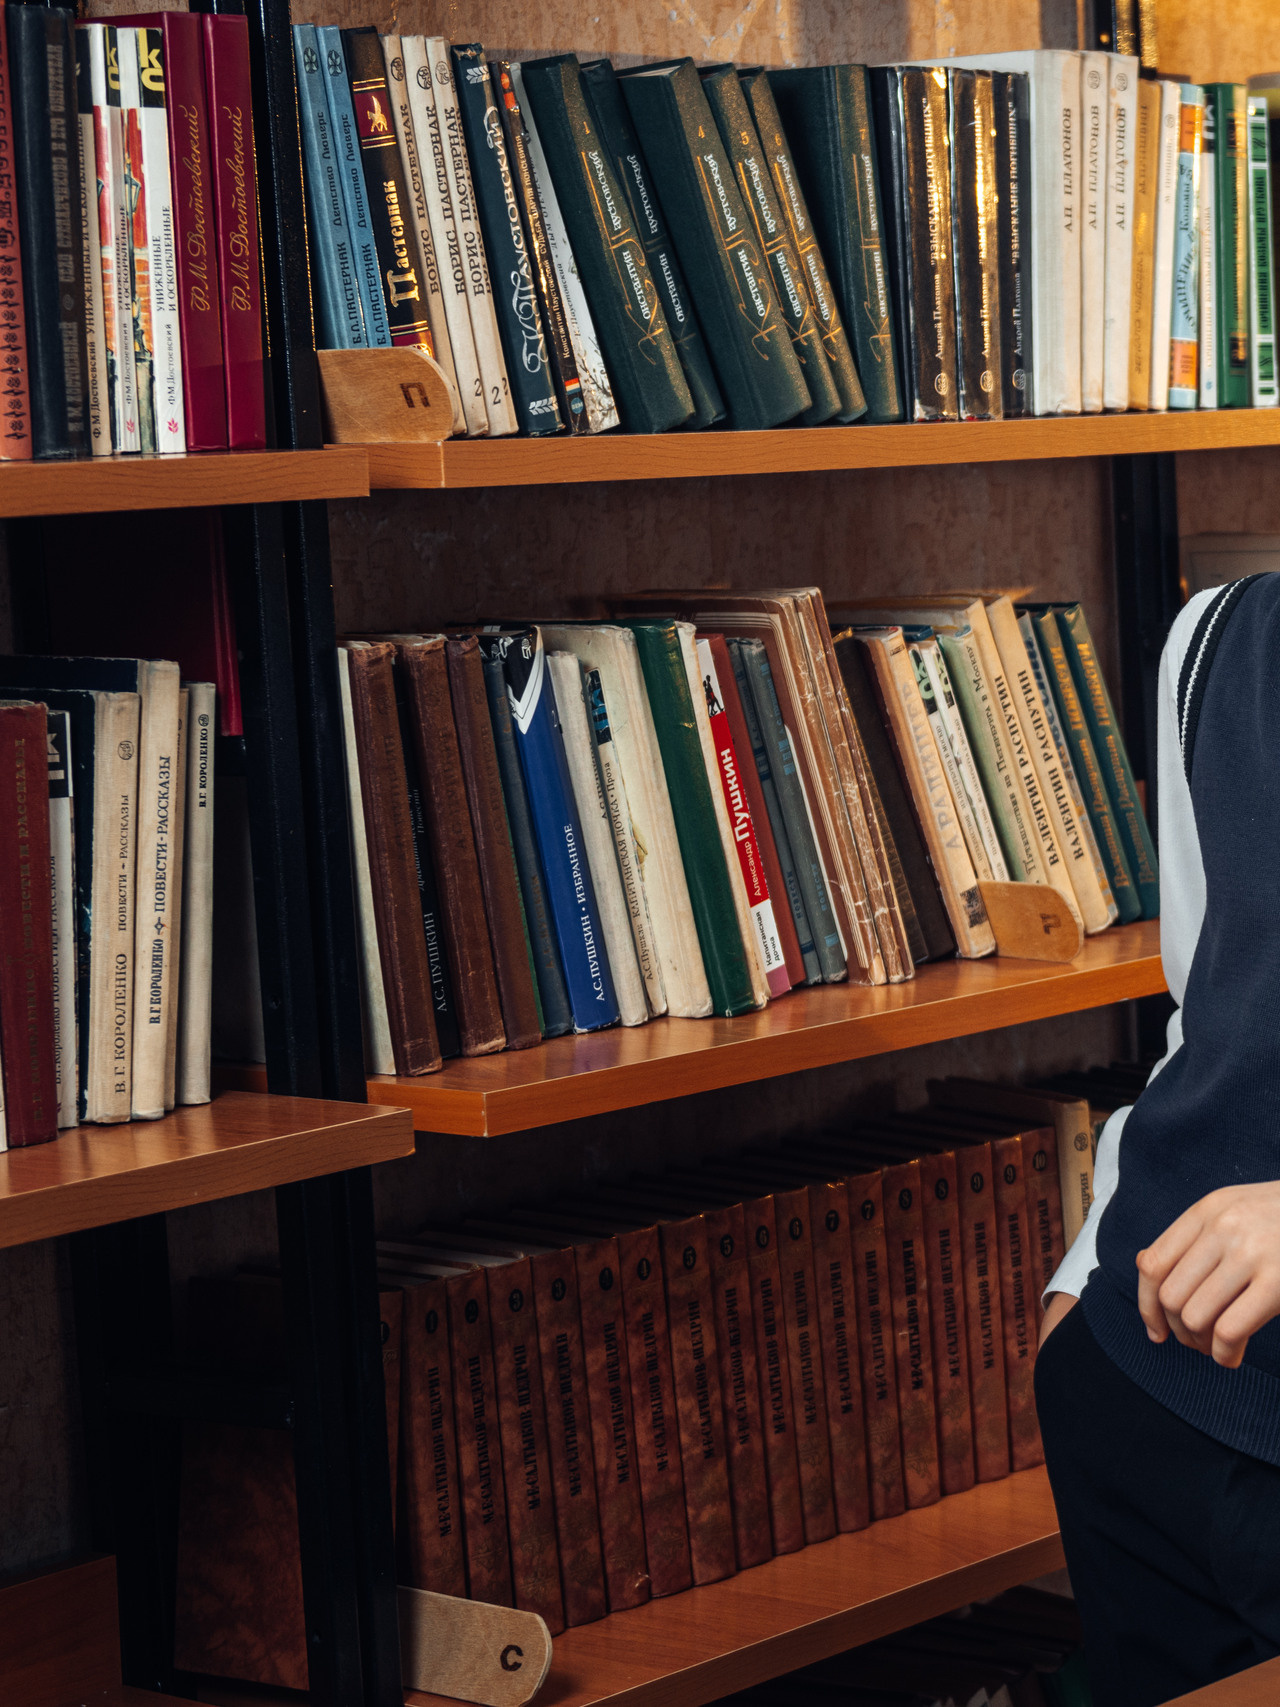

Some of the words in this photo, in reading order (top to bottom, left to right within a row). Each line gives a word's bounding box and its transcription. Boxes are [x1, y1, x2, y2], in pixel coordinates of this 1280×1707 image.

[316, 111, 331, 160] Люверс
[340, 113, 355, 162] Люверс
[399, 103, 426, 220] ПАСТЕРНАК
[425, 105, 451, 220] ПАСТЕРНАК
[443, 106, 471, 222] ПАСТЕРНАК
[514, 134, 533, 187] ЛОНСЕВИЛЯ
[1062, 107, 1073, 196] ПЛАТОНОВ
[1087, 105, 1099, 193] ПЛАТОНОВ
[1115, 107, 1126, 193] ПЛАТОНОВ
[325, 166, 342, 227] Детство
[350, 168, 367, 228] Детство
[526, 187, 540, 219] ШАРЛЯ
[162, 205, 175, 300] ОСКОРБЛЕННЫЕ
[382, 179, 420, 308] Пастернак
[420, 229, 440, 295] БОРИС
[444, 229, 466, 295] БОРИС
[464, 231, 486, 297] БОРИС
[532, 221, 547, 255] СУДЬБА
[82, 246, 95, 334] УНИЖЕННЫЕ
[151, 235, 164, 311] УНИЖЕННЫЕ
[542, 259, 561, 311] Паустовский
[932, 273, 943, 321] Платонов
[1011, 272, 1022, 318] Платонов
[554, 311, 571, 359] Константин
[934, 321, 944, 361] Андрей
[1013, 319, 1022, 356] Андрей
[400, 381, 430, 408] П
[492, 386, 501, 405] 2
[1017, 669, 1054, 763] РАСПУТИН
[1051, 646, 1083, 730] ПОВЕСТИ
[1077, 643, 1111, 726] ПОВЕСТИ
[993, 675, 1029, 768] РАСПУТИН
[199, 728, 208, 788] КОРОЛЕНКО
[603, 761, 615, 792] Проза
[118, 794, 130, 859] РАССКАЗЫ
[610, 799, 626, 836] ДОЧКА
[721, 748, 751, 842] Пушкин
[1023, 773, 1060, 866] ВАЛЕНТИН
[1048, 766, 1085, 861] ВАЛЕНТИН
[564, 823, 586, 903] ИЗБРАННОЕ
[618, 839, 641, 918] КАПИТАНСКАЯ
[743, 841, 762, 898] Александр
[787, 871, 803, 918] ПОВЕСТИ
[811, 863, 828, 911] ПОВЕСТИ
[117, 874, 128, 931] ПОВЕСТИ
[423, 912, 443, 982] ПУШКИН
[755, 912, 772, 966] Капитанская
[113, 953, 128, 1061] КОРОЛЕНКО
[500, 1645, 523, 1671] С
